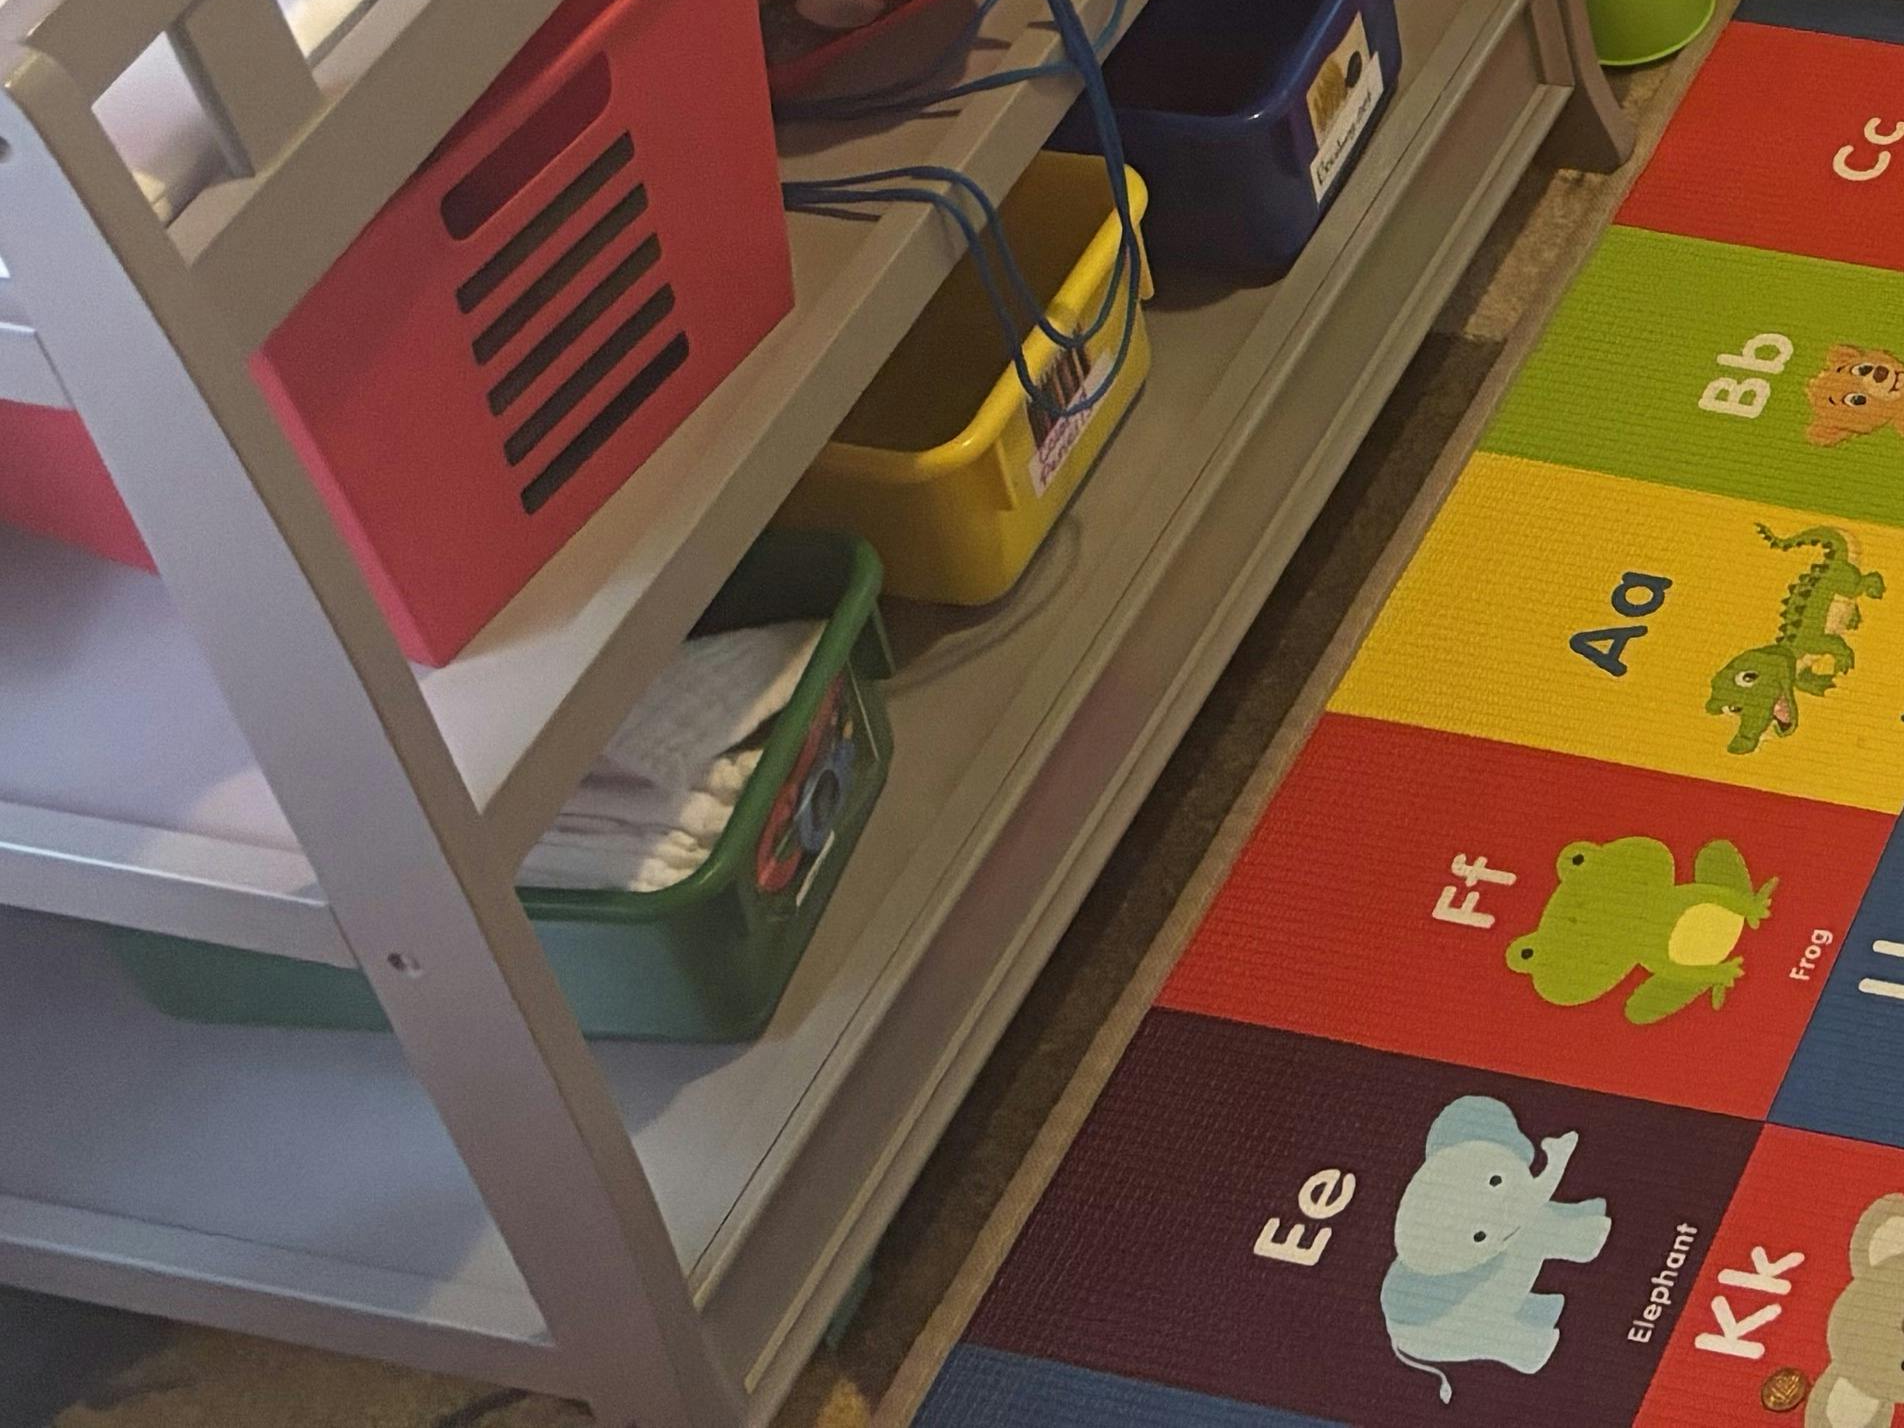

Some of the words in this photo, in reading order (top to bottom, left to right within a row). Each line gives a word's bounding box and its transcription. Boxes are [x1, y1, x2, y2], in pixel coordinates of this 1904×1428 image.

[1698, 333, 1794, 420] Bb
[1568, 571, 1674, 677] Aa
[1432, 853, 1517, 929] Ff
[1790, 928, 1834, 982] Frog
[1254, 1168, 1358, 1267] Ee
[1628, 1223, 1697, 1344] Elephant
[1695, 1245, 1805, 1359] Kk
